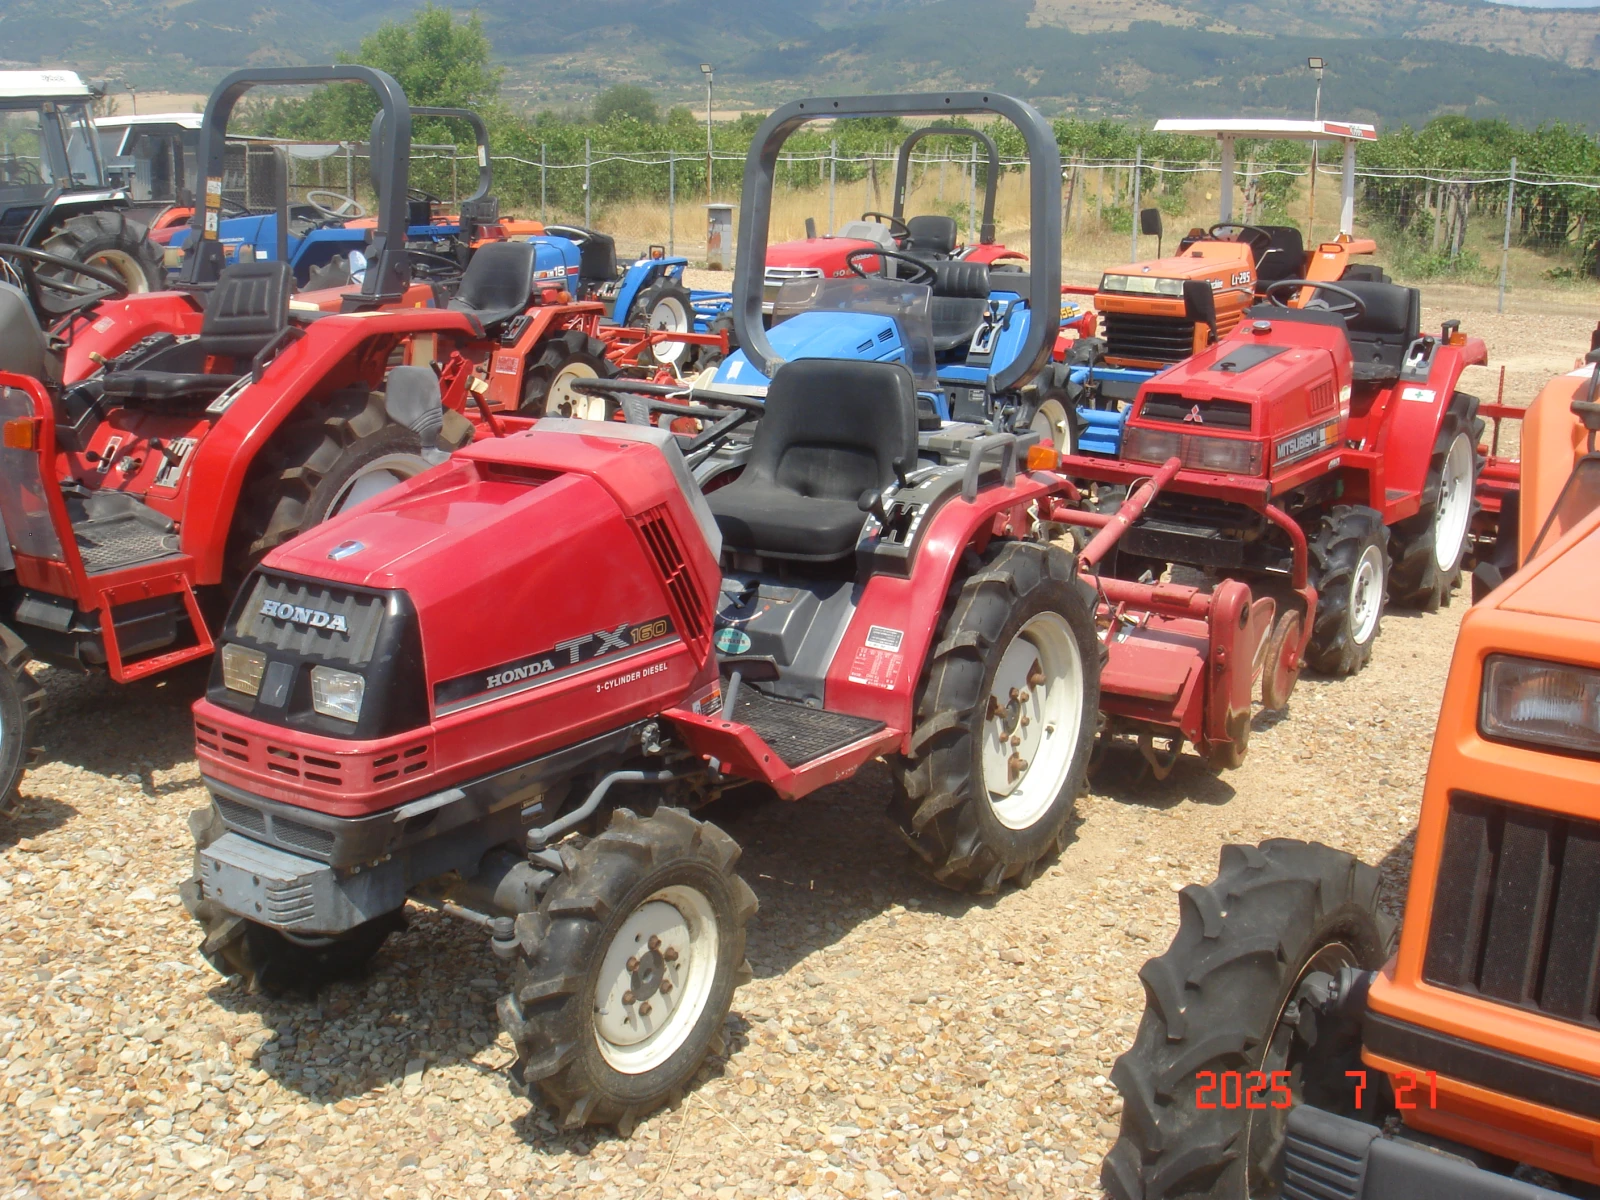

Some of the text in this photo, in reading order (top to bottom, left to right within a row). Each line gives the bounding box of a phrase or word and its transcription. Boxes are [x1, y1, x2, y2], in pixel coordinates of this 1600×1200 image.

[1060, 306, 1074, 320] 55
[1277, 428, 1318, 459] MITSUBISHI
[259, 599, 349, 633] HONDA
[486, 659, 555, 689] HONDA
[596, 662, 668, 693] 3-CYLINDER DIESEL
